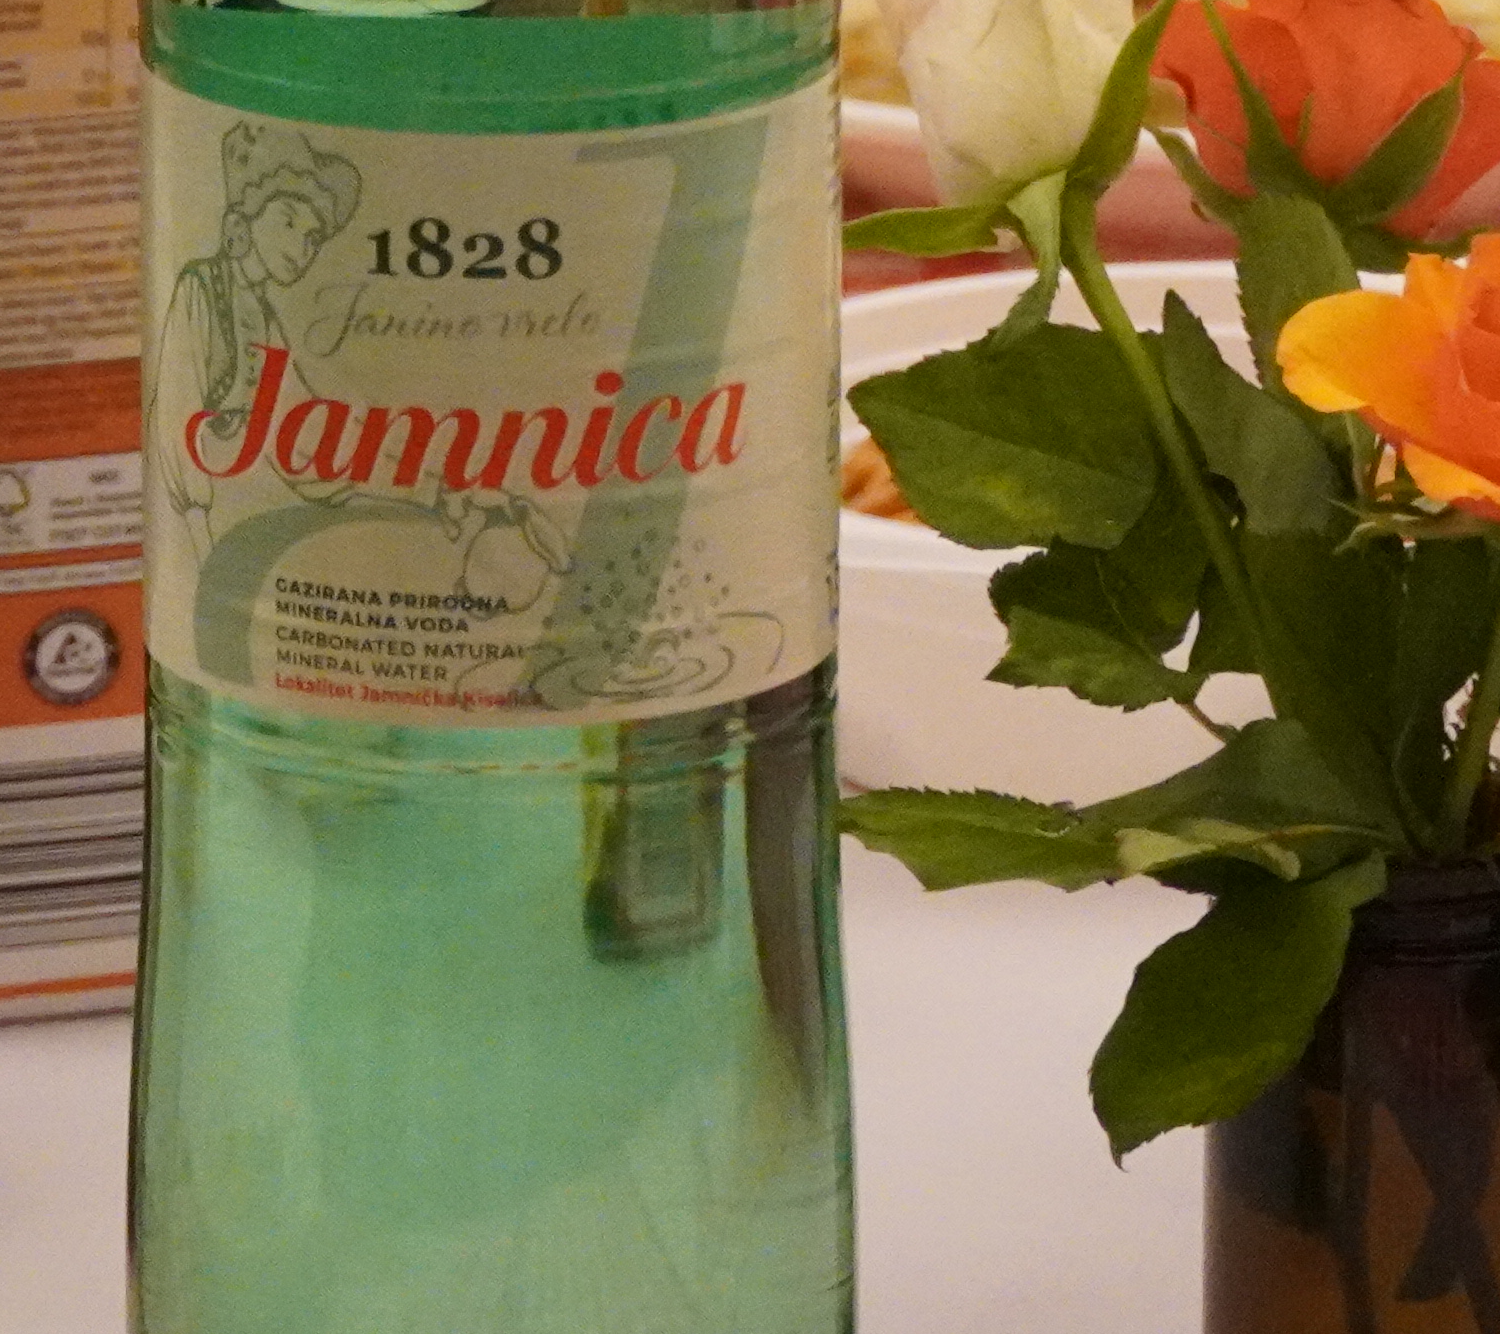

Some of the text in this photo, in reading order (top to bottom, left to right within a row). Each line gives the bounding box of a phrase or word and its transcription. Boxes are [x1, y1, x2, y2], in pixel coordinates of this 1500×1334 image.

[366, 216, 563, 281] 1828
[185, 343, 747, 492] Jamnica
[274, 577, 384, 607] GAZIRANA
[274, 599, 469, 634] MINERALNA VODA
[274, 625, 417, 658] CARBONATED
[275, 647, 449, 682] MINERAL WATER
